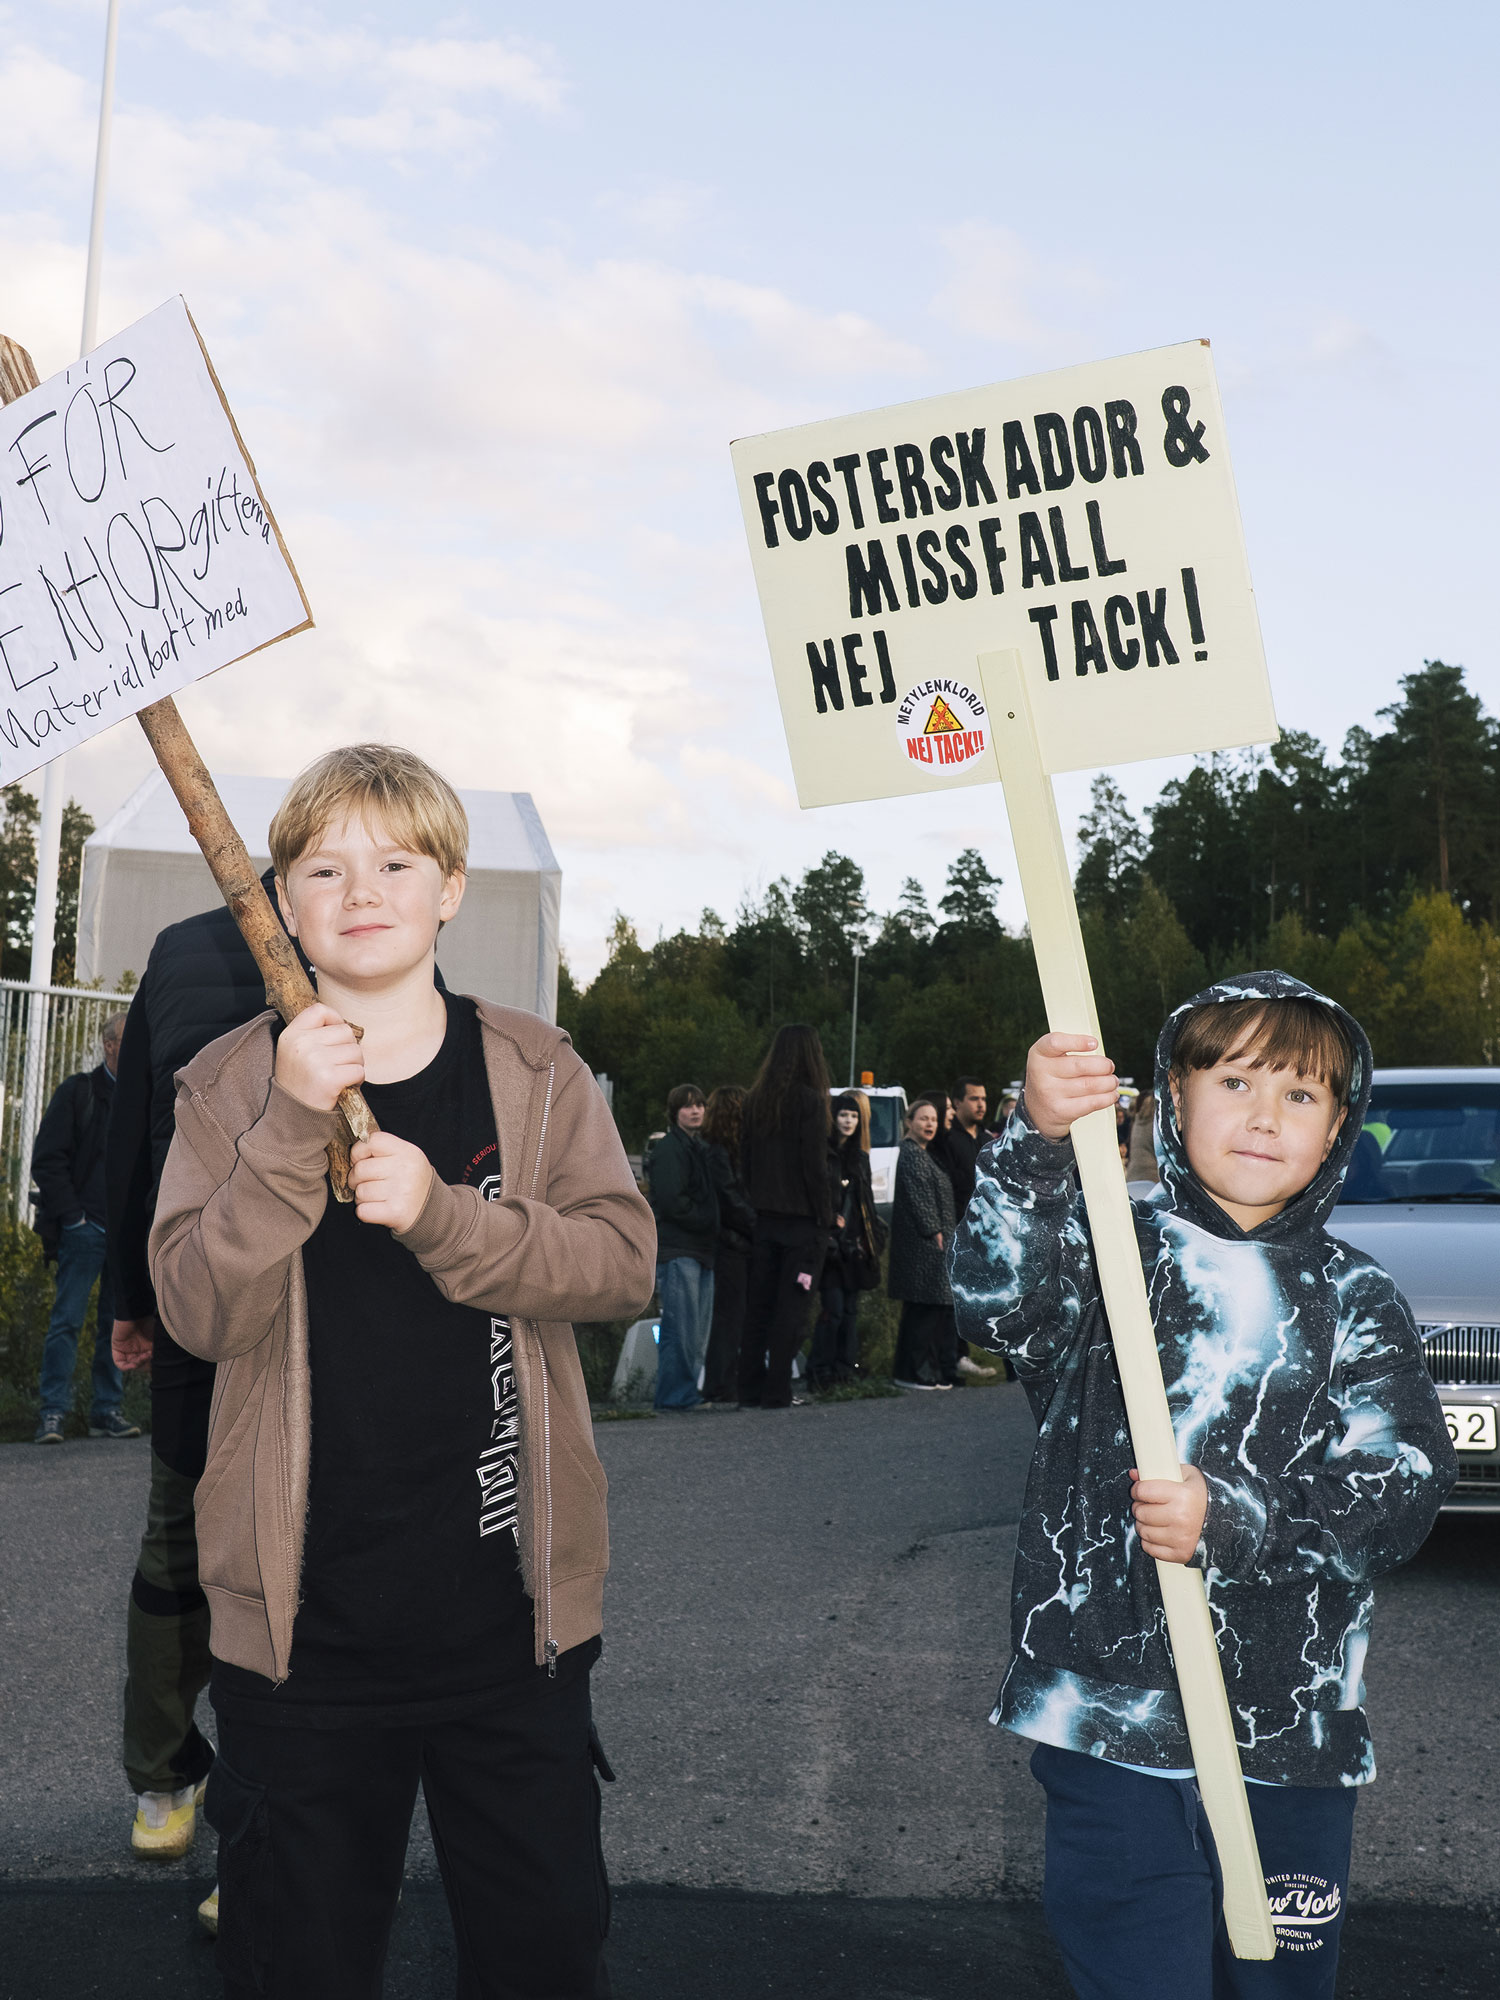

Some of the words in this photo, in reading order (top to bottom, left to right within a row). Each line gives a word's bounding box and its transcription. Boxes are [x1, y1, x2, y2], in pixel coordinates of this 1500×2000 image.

[9, 357, 176, 525] FÖR
[753, 400, 1145, 549] FOSTERSKADOR
[1160, 385, 1211, 468] &
[189, 466, 270, 580] gitterna
[845, 499, 1127, 619] MISSFALL
[141, 608, 195, 680] bort
[205, 587, 248, 640] med
[805, 630, 898, 713] NEJ
[1028, 567, 1210, 682] TACK!
[897, 679, 985, 725] METYLENKLORID
[906, 736, 933, 764] NEJ
[933, 730, 985, 765] TACK!!
[472, 1142, 498, 1165] SERIOU
[1264, 1873, 1291, 1885] UNITED
[1293, 1873, 1328, 1888] ATHLETICS
[1286, 1882, 1341, 1917] York
[1275, 1926, 1312, 1940] BROOKLYN
[1286, 1942, 1305, 1952] TOUR
[1306, 1938, 1324, 1951] TEAM
